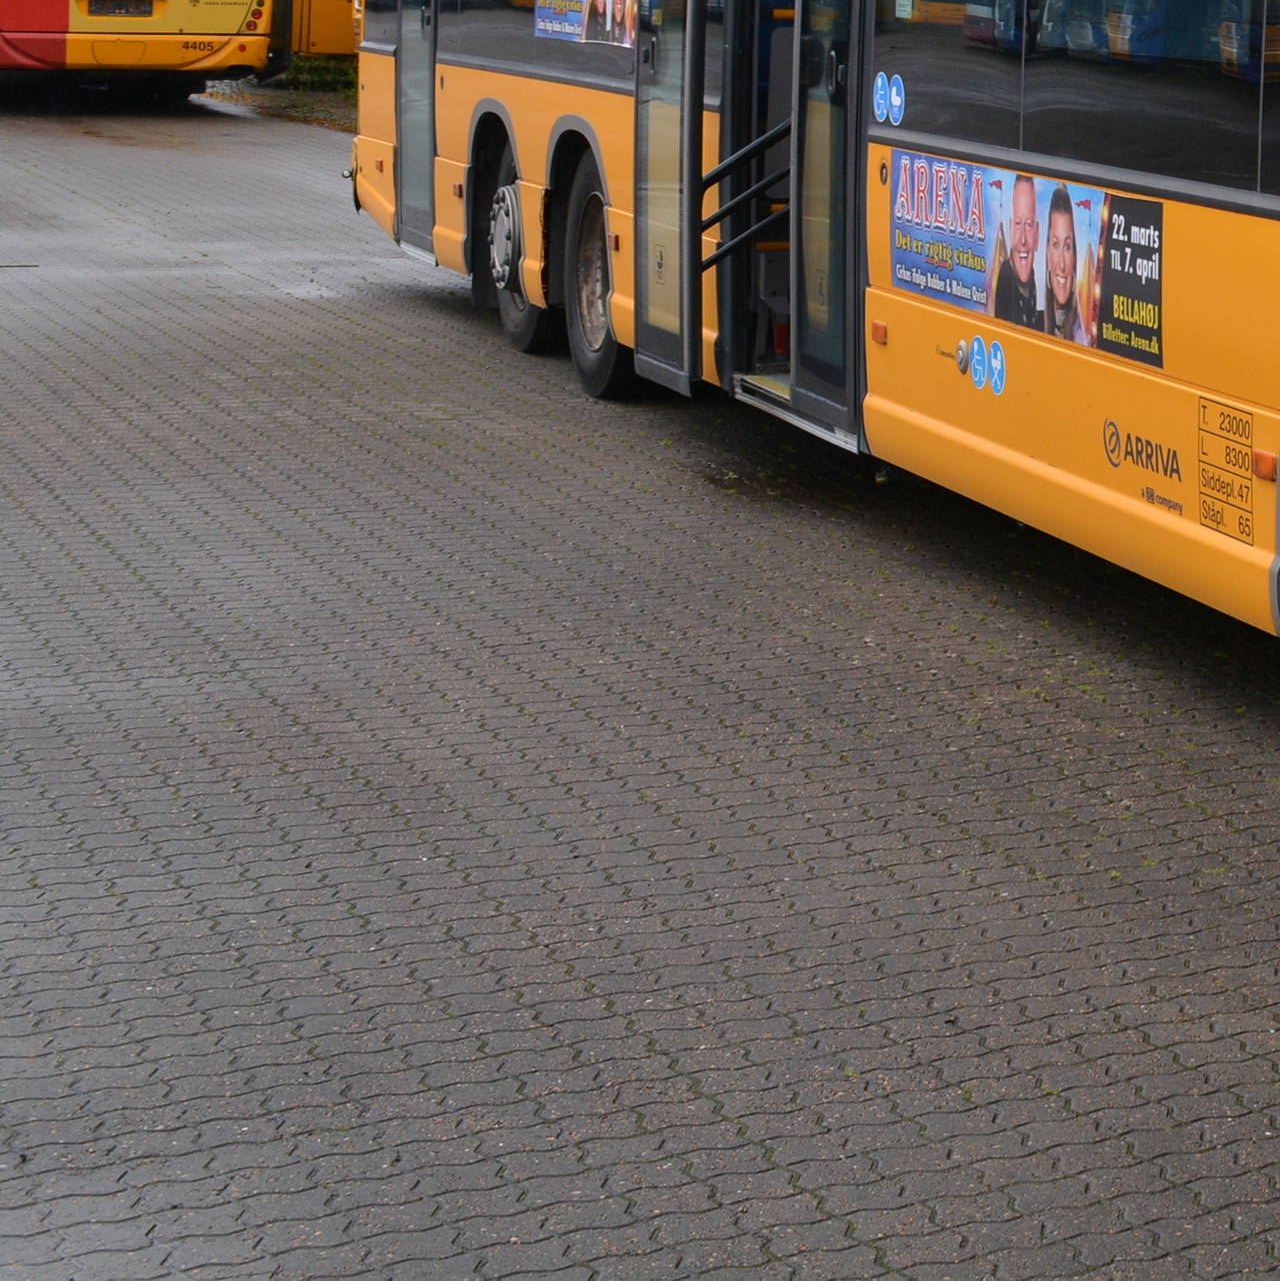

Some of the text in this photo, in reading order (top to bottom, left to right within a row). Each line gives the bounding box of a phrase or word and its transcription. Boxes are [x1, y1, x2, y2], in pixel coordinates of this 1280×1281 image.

[182, 41, 214, 52] 4405
[895, 156, 986, 243] ARENA
[1112, 213, 1160, 249] 22. marts
[895, 228, 986, 273] Det er rigtig cirkus
[1110, 247, 1160, 285] TIL 7. april
[1113, 294, 1159, 330] BELLAHØJ
[1201, 405, 1251, 441] T. 23000
[1124, 432, 1182, 483] ARRIVA
[1224, 445, 1250, 472] 8300
[1201, 468, 1250, 504] Siddepl. 47
[1156, 494, 1183, 516] company
[1202, 499, 1251, 537] Ståpl. 65
